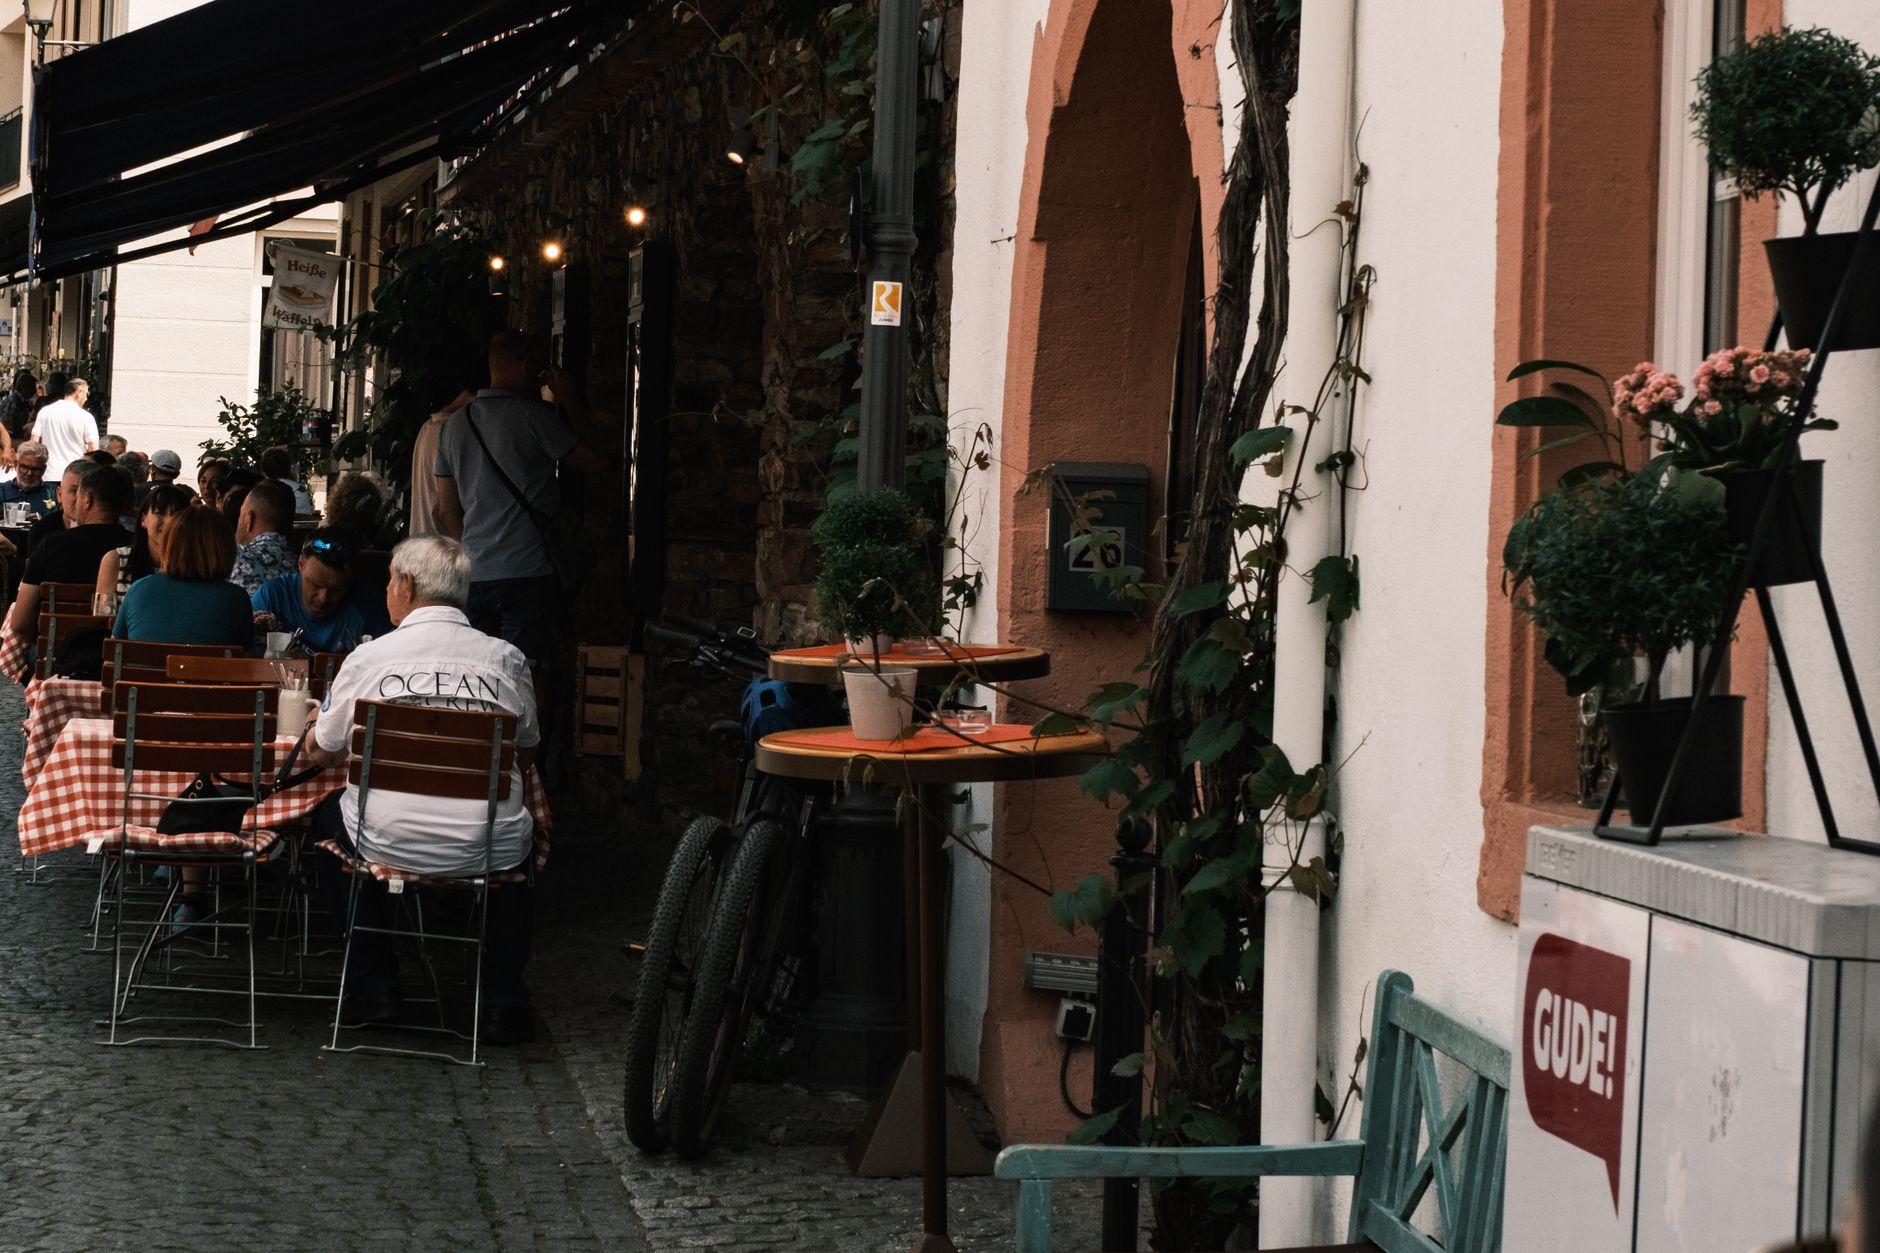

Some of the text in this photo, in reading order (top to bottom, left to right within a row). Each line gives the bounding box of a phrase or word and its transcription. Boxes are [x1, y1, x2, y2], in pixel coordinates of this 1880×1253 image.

[287, 260, 327, 278] Heiße
[379, 671, 500, 702] OCEAN
[424, 697, 496, 713] REW
[1533, 987, 1618, 1100] GUDE!
